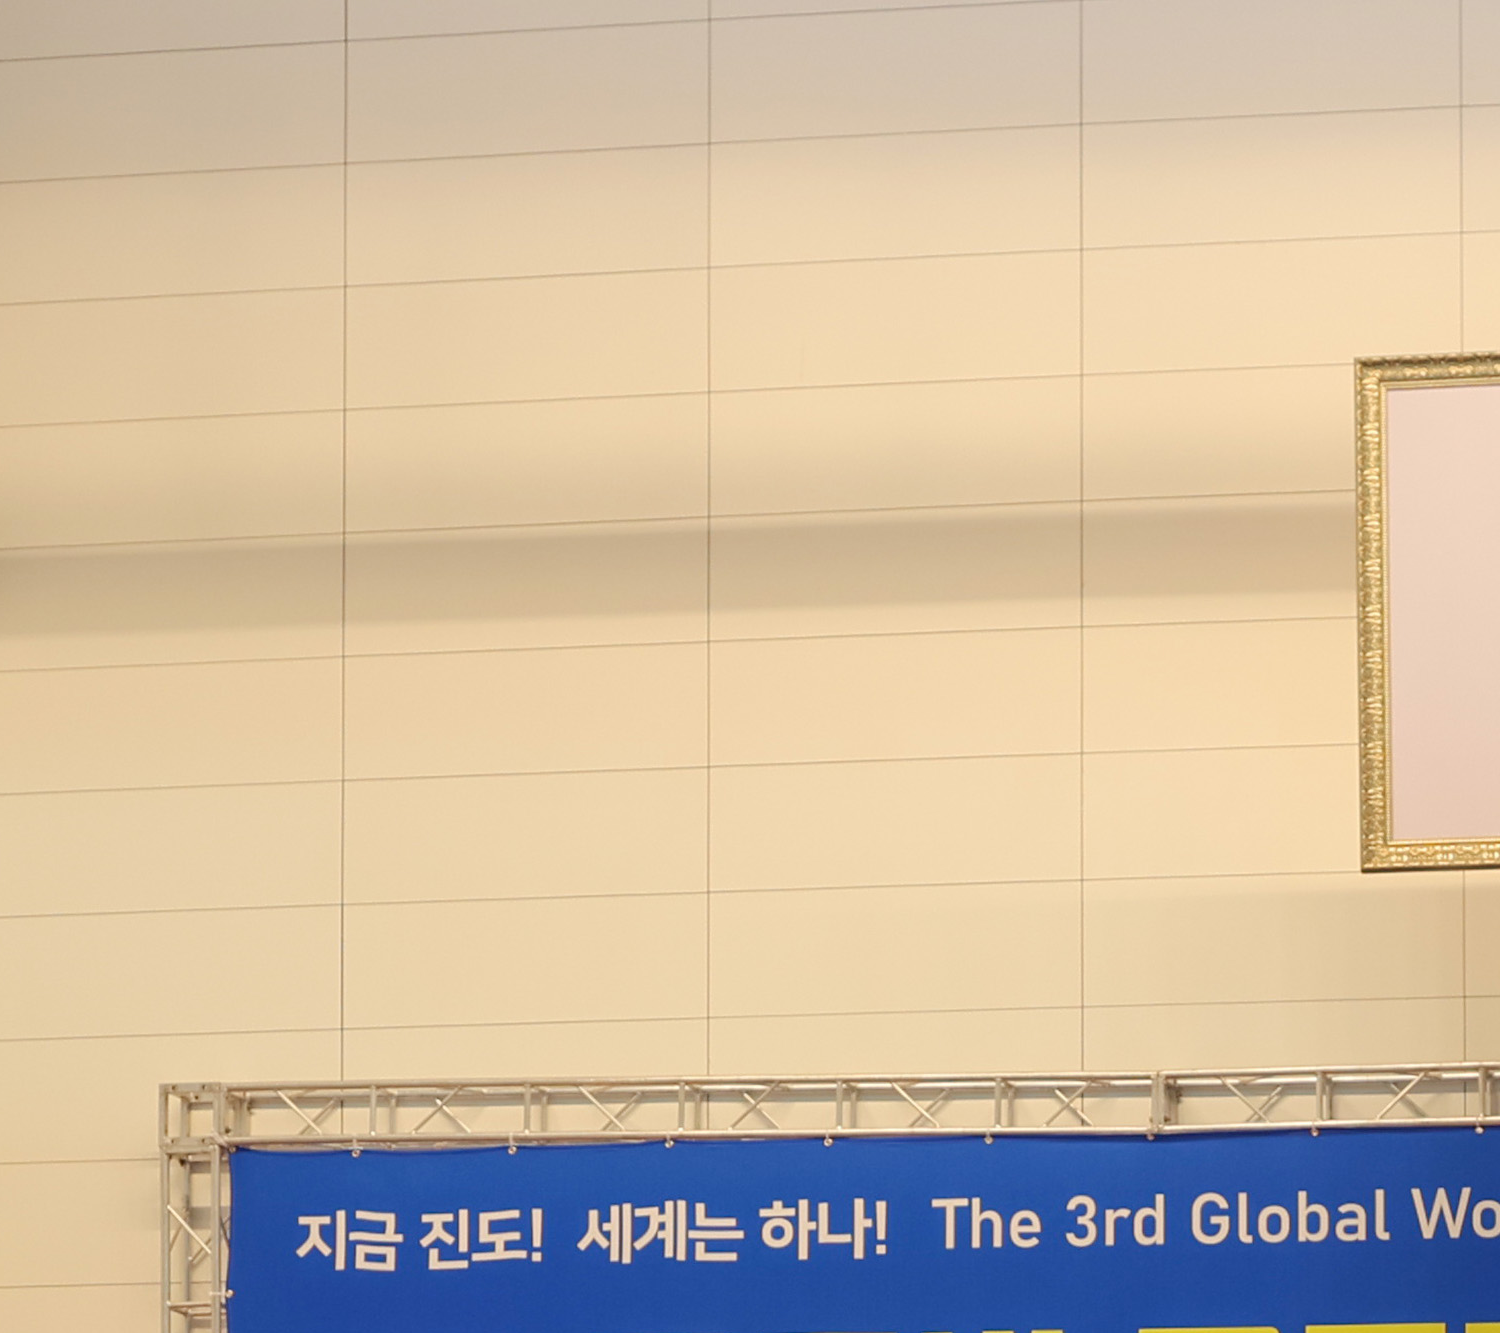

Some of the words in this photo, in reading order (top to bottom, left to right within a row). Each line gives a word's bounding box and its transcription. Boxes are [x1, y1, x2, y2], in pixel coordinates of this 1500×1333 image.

[295, 1207, 403, 1271] 지금
[418, 1207, 543, 1270] 진도!
[576, 1199, 745, 1264] 세계는
[758, 1197, 890, 1261] 하나!
[932, 1197, 1041, 1249] The
[1065, 1194, 1165, 1247] 3rd
[1190, 1189, 1390, 1246] Global
